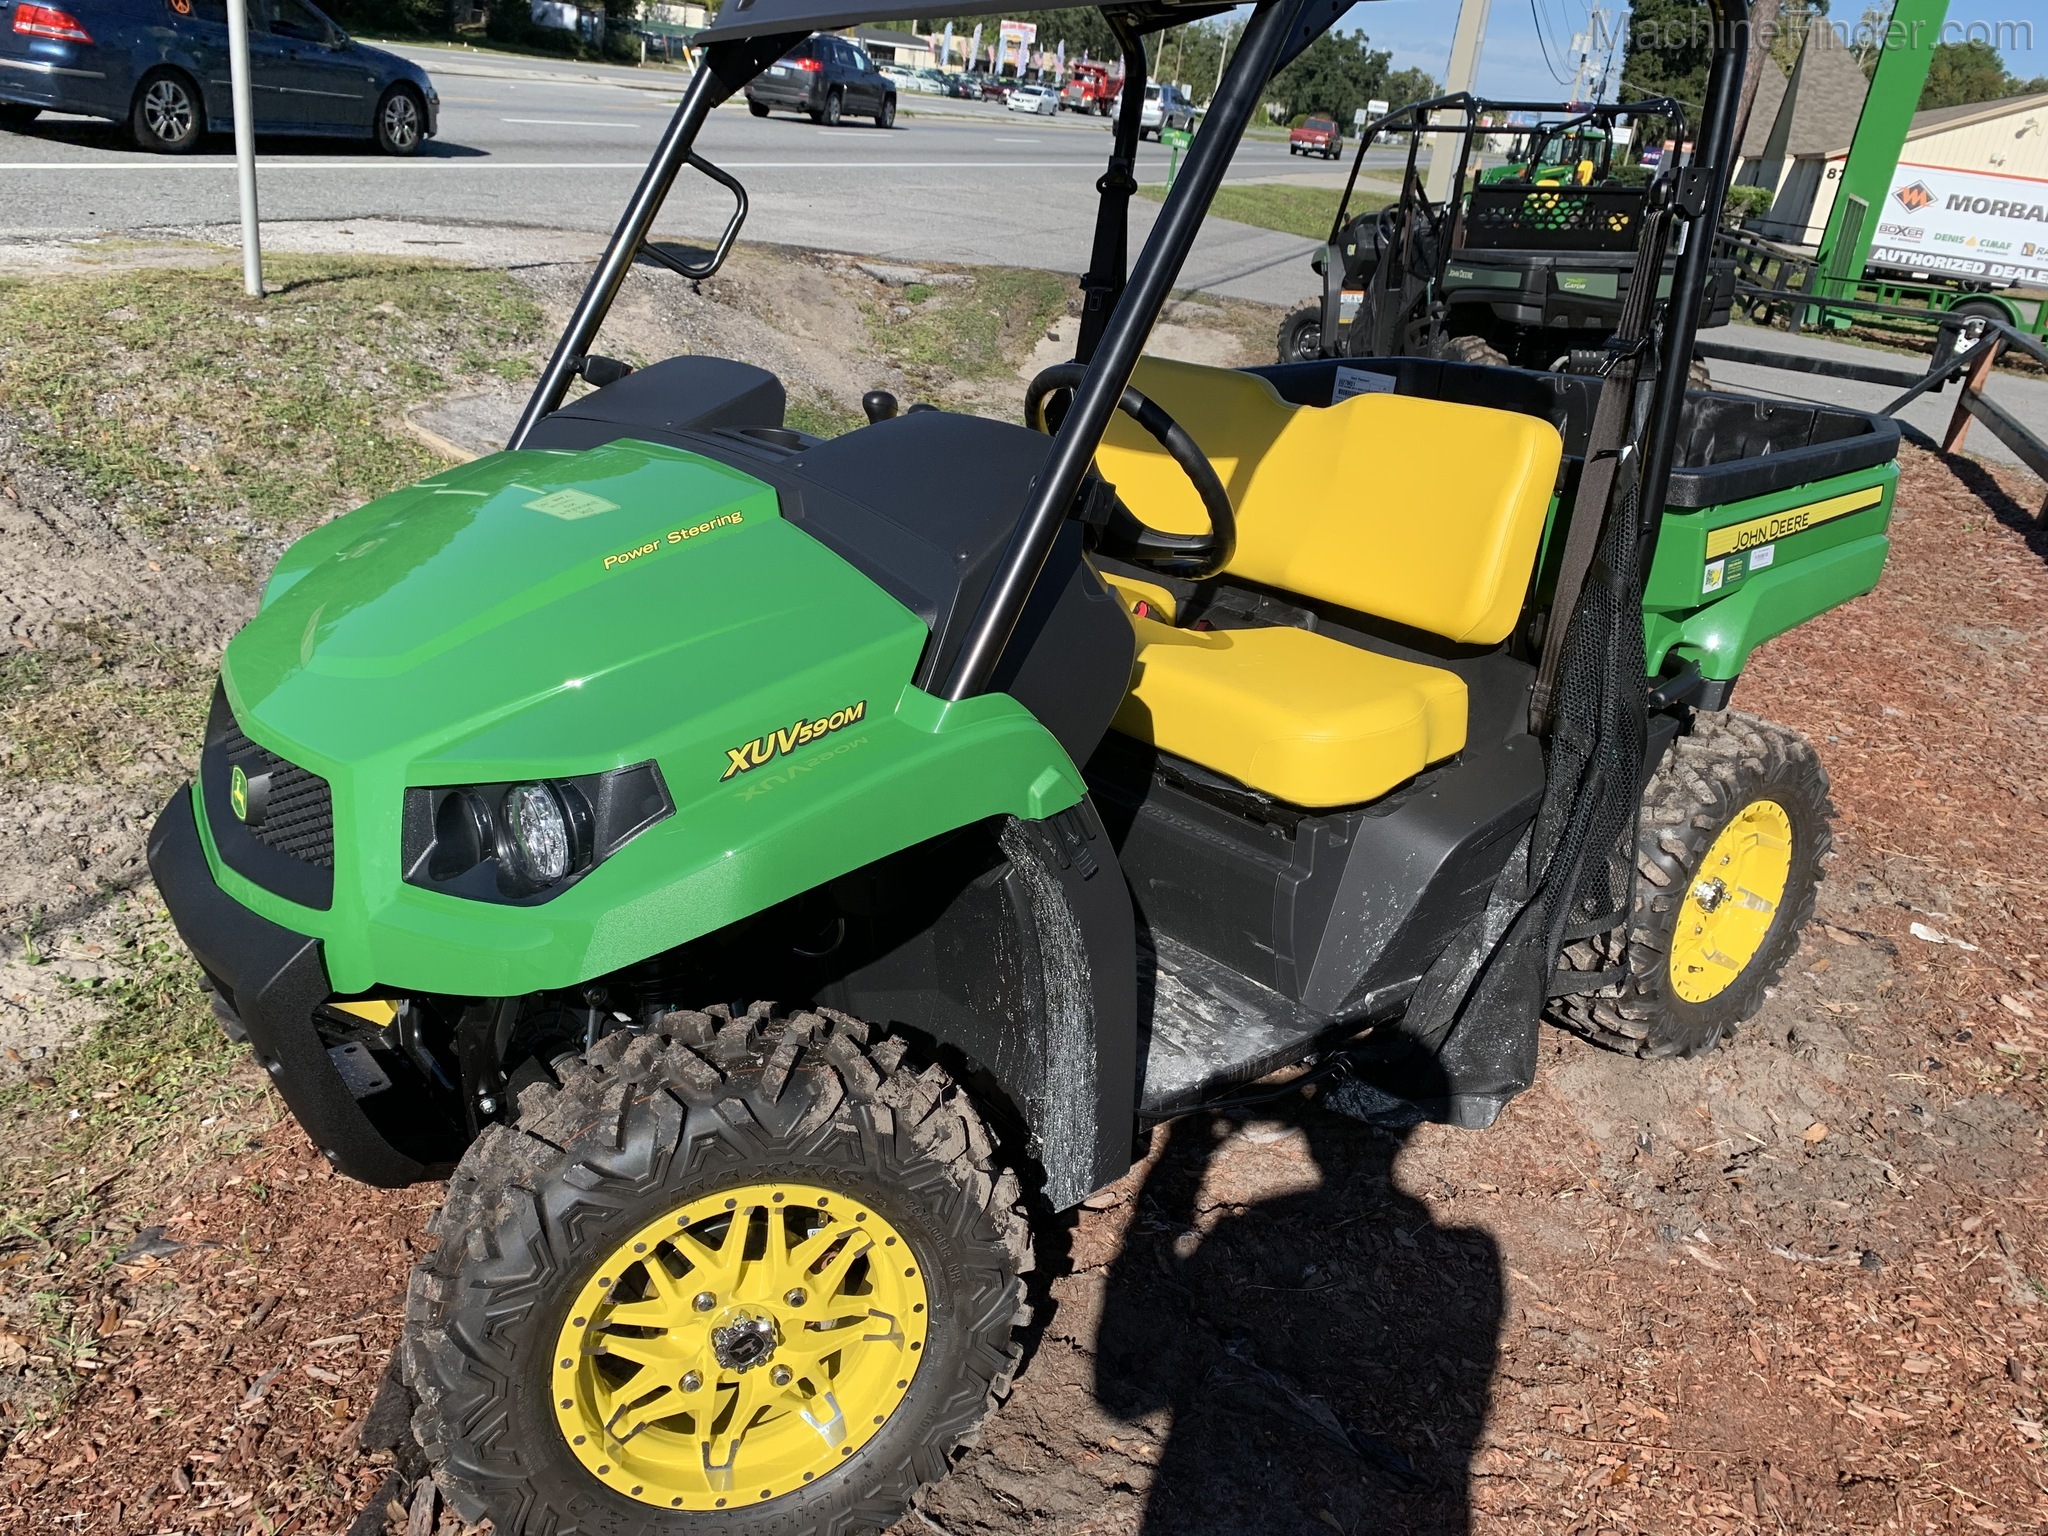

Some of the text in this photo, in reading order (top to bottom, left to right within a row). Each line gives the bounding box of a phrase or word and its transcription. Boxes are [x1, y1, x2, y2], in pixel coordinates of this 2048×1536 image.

[1945, 193, 2048, 223] MORBA
[1878, 223, 1925, 239] BOXER
[1933, 232, 2013, 250] DENIS CIMAF
[1873, 248, 1986, 275] AUTHORIZED
[1564, 282, 1586, 290] GATOR
[603, 510, 744, 571] Power Steering
[1732, 512, 1810, 551] JOHN DEERE
[718, 700, 867, 783] XUV590M
